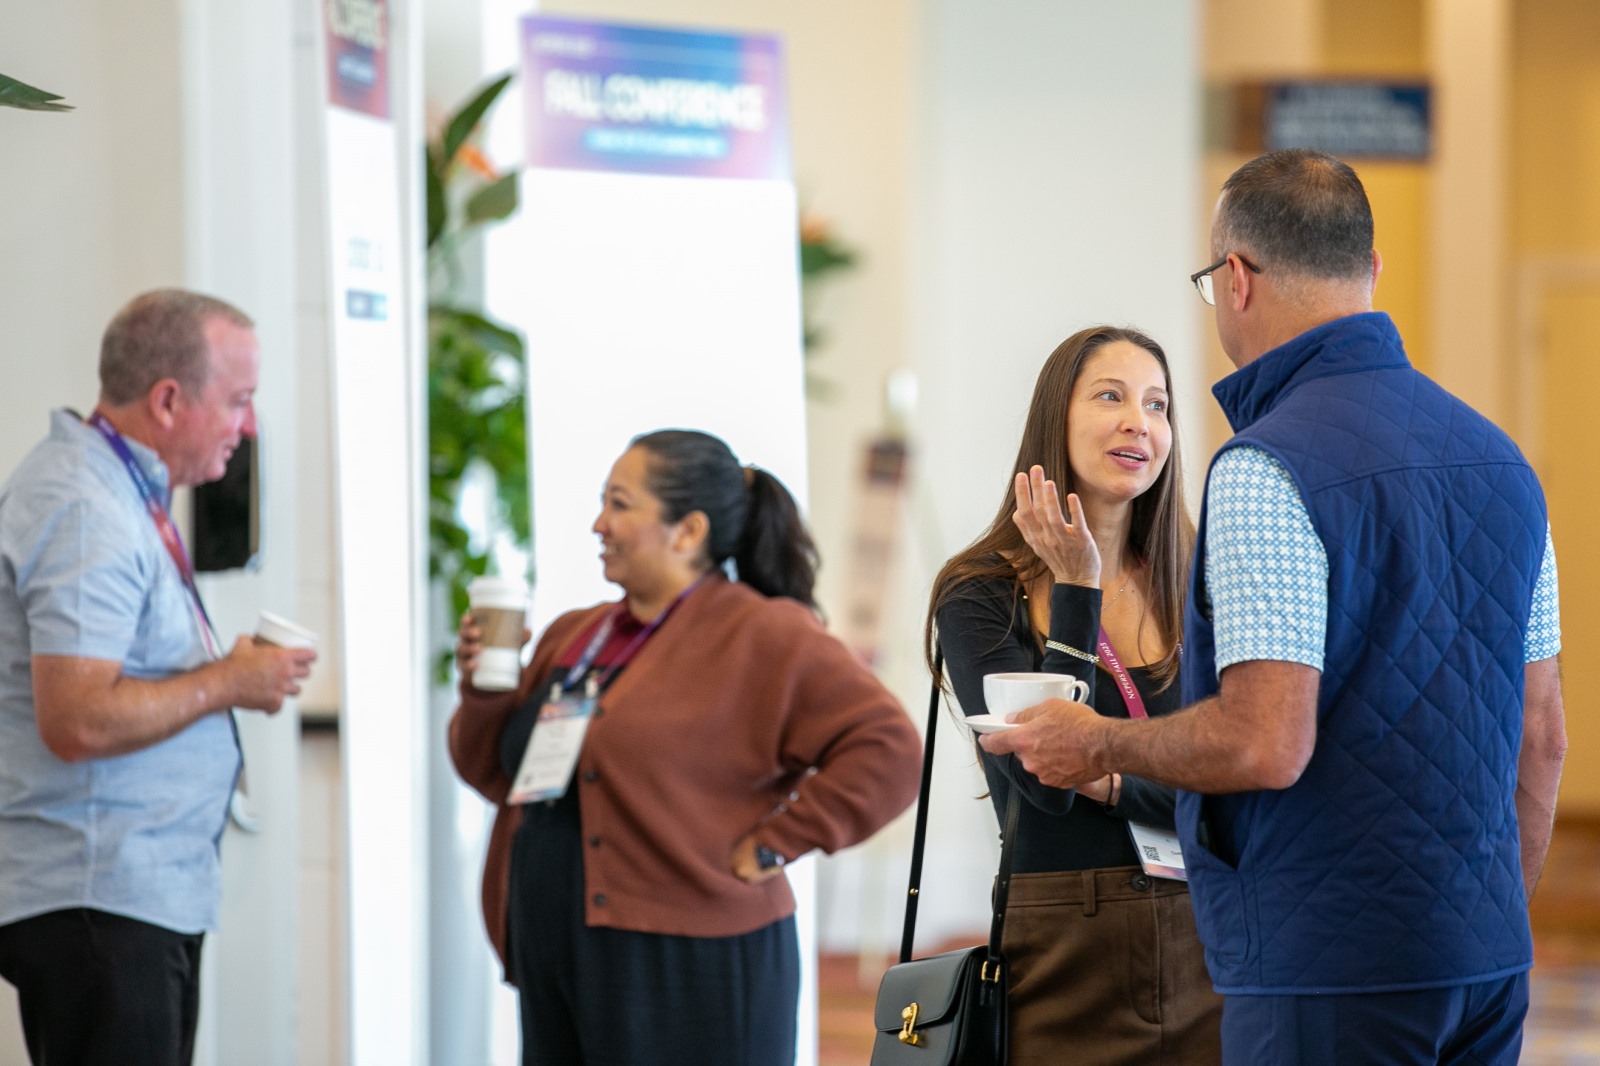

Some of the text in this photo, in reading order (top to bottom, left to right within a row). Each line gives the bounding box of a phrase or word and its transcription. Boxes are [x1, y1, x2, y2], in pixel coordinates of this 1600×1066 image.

[545, 69, 765, 131] FALL CONFERENCE
[1110, 658, 1123, 673] FALL
[1119, 674, 1136, 699] NCPERS
